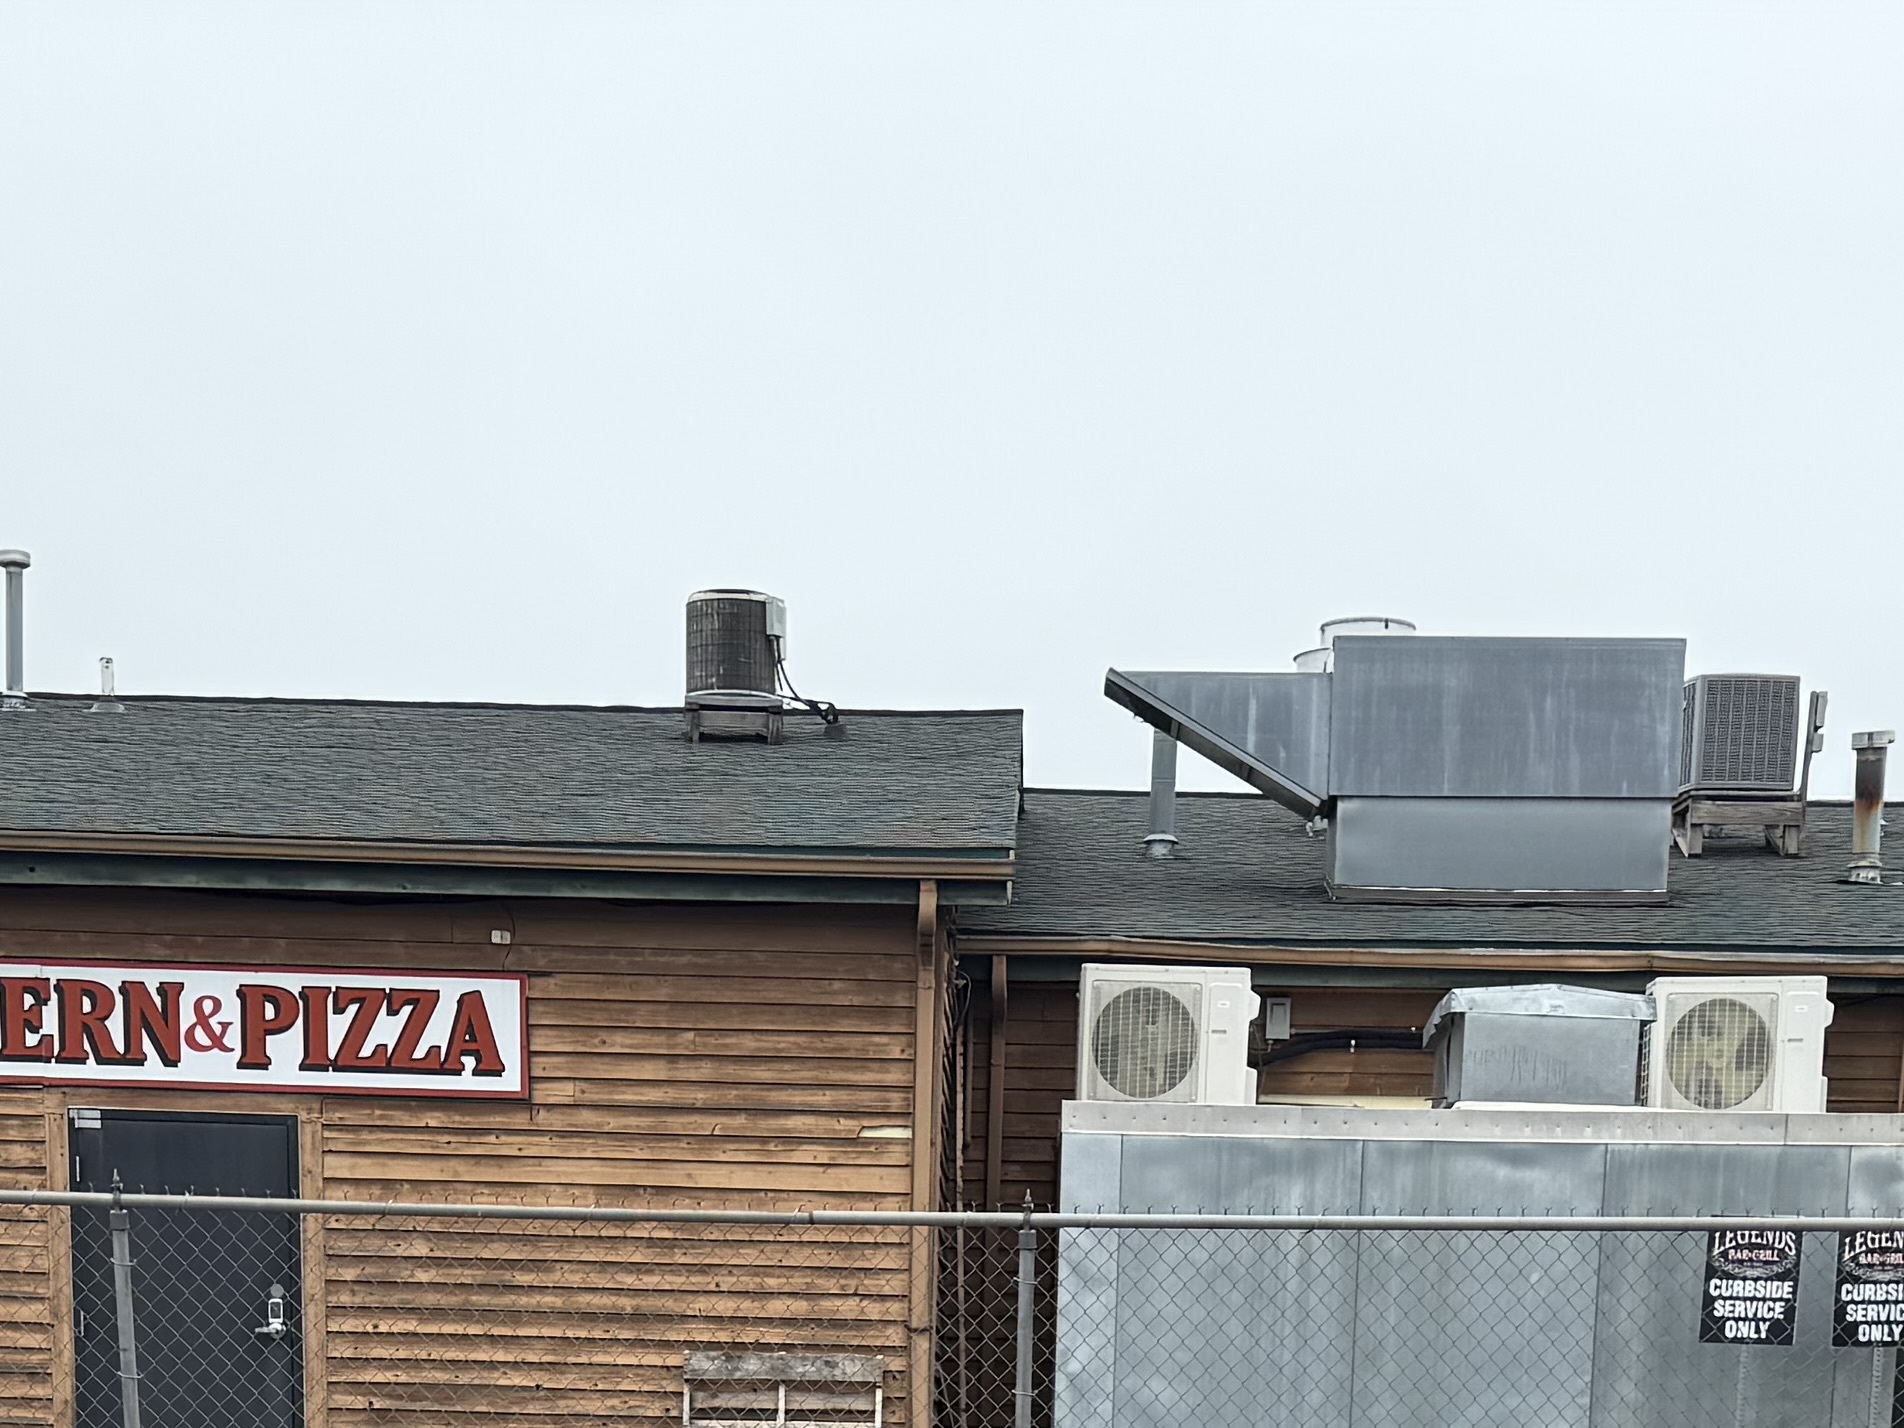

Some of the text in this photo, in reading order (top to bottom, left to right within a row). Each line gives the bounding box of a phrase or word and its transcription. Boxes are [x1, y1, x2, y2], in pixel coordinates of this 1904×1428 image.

[236, 984, 506, 1078] PIZZA
[1709, 1278, 1794, 1299] CURBSIDE
[1713, 1299, 1786, 1319] SERVICE
[1724, 1320, 1770, 1339] ONLY
[1858, 1324, 1904, 1342] ONLY
